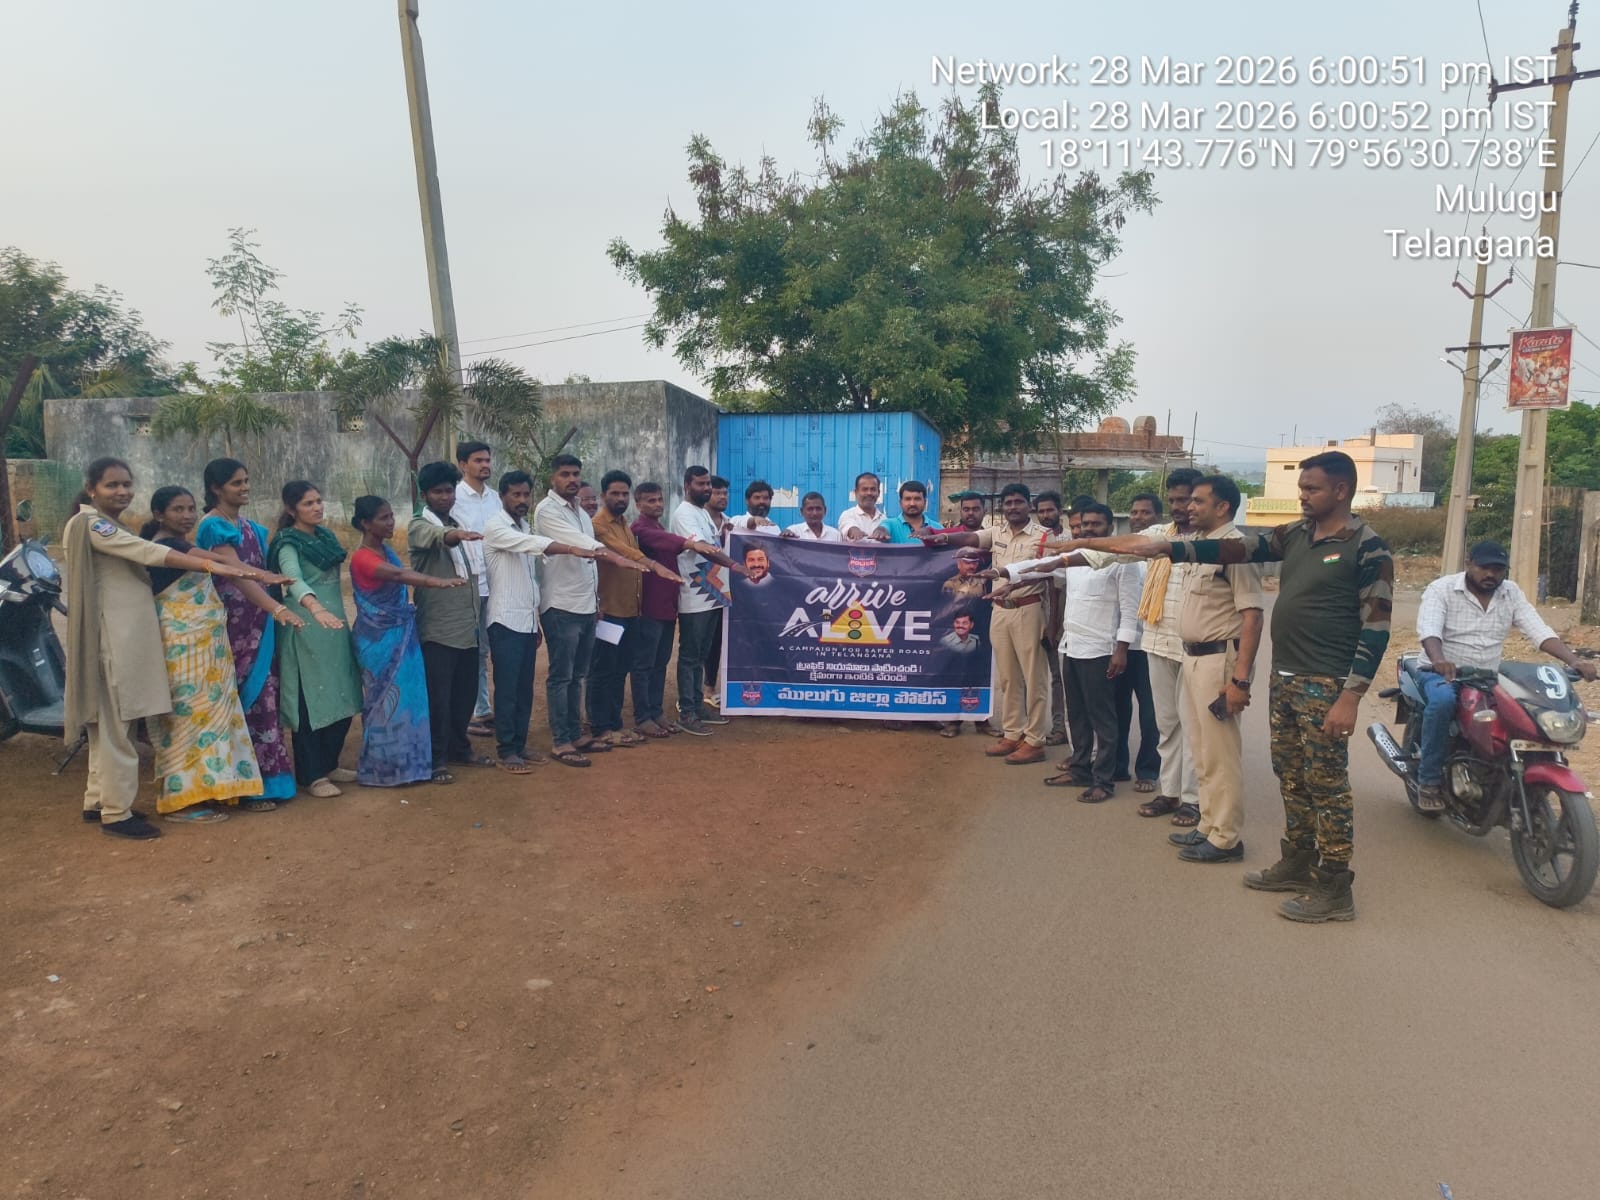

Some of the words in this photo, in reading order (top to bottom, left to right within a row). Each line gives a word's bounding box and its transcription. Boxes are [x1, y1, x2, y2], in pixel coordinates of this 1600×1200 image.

[805, 578, 907, 610] arrive
[826, 662, 870, 672] నియమాలు
[1536, 665, 1567, 700] 9
[777, 687, 845, 702] ములుగు
[850, 691, 890, 707] జిల్లా
[895, 690, 947, 705] పోలీస్
